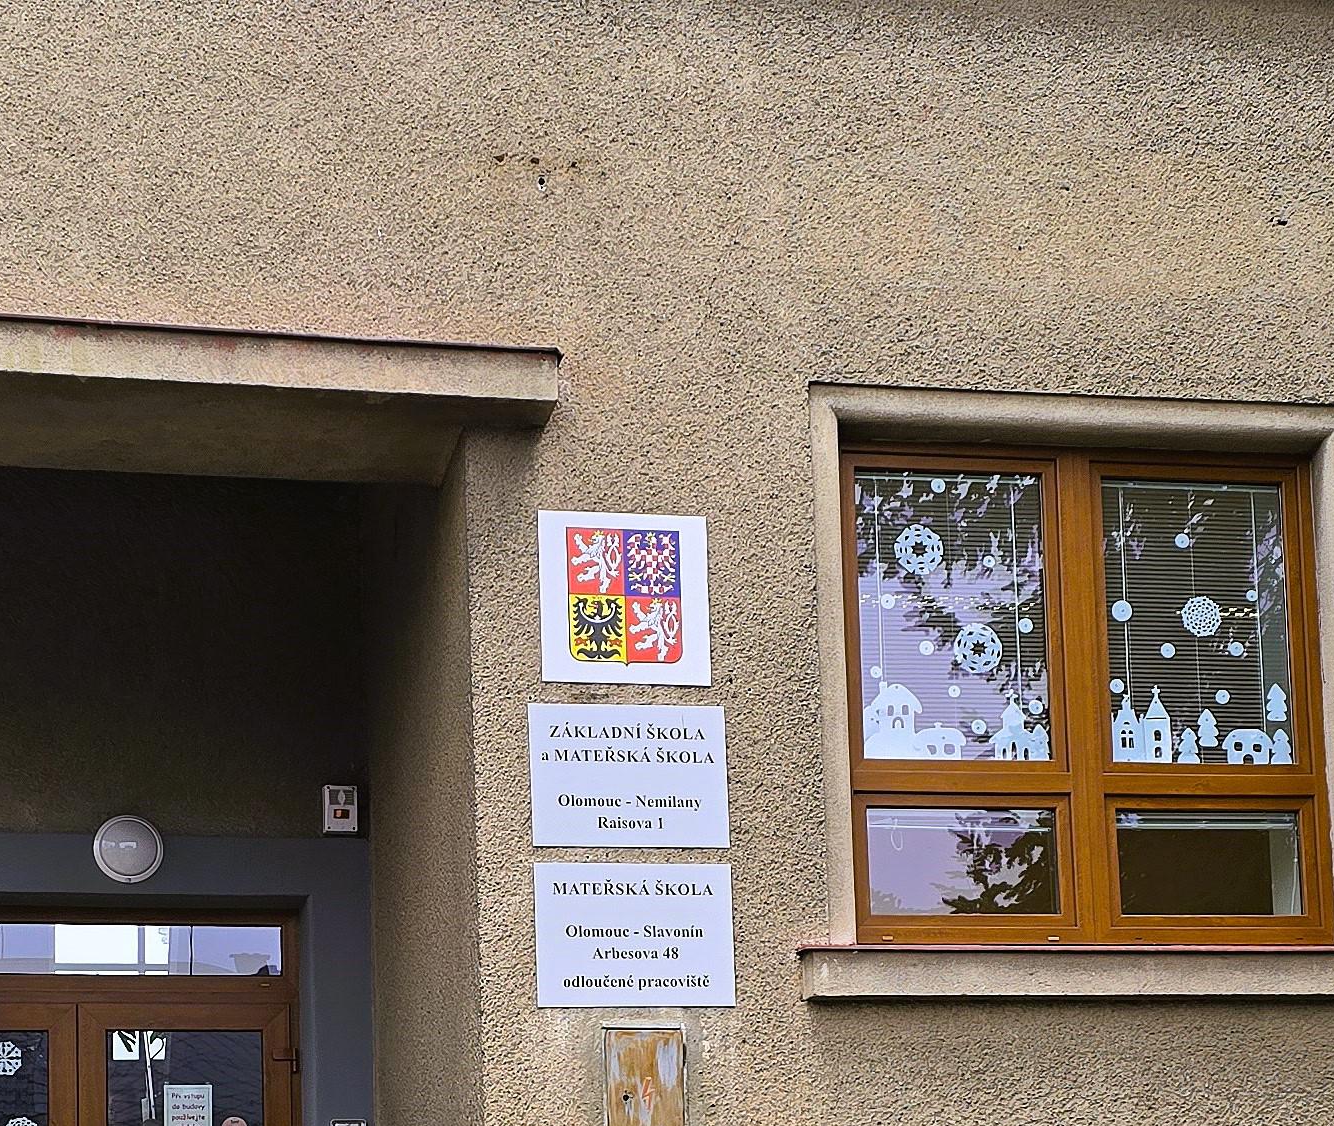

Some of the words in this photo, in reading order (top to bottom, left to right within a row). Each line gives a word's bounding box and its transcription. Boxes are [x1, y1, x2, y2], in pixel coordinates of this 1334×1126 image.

[549, 722, 641, 739] ZÁKLADNÍ
[646, 723, 705, 740] ŠKOLA
[541, 751, 549, 761] a
[554, 746, 651, 763] MATEŘSKÁ
[656, 747, 714, 764] ŠKOLA
[558, 794, 622, 808] Olomouc
[636, 795, 702, 811] Nemilany
[597, 816, 652, 829] Raisova
[658, 817, 664, 829] 1
[553, 879, 650, 896] MATEŘSKÁ
[655, 880, 714, 896] ŠKOLA
[565, 925, 630, 938] Olomouc
[643, 925, 704, 938] Slavonín
[592, 947, 659, 960] Arbesova
[662, 947, 679, 960] 48
[563, 974, 634, 988] odloučené
[638, 974, 710, 990] pracoviště
[182, 1103, 205, 1111] budovy
